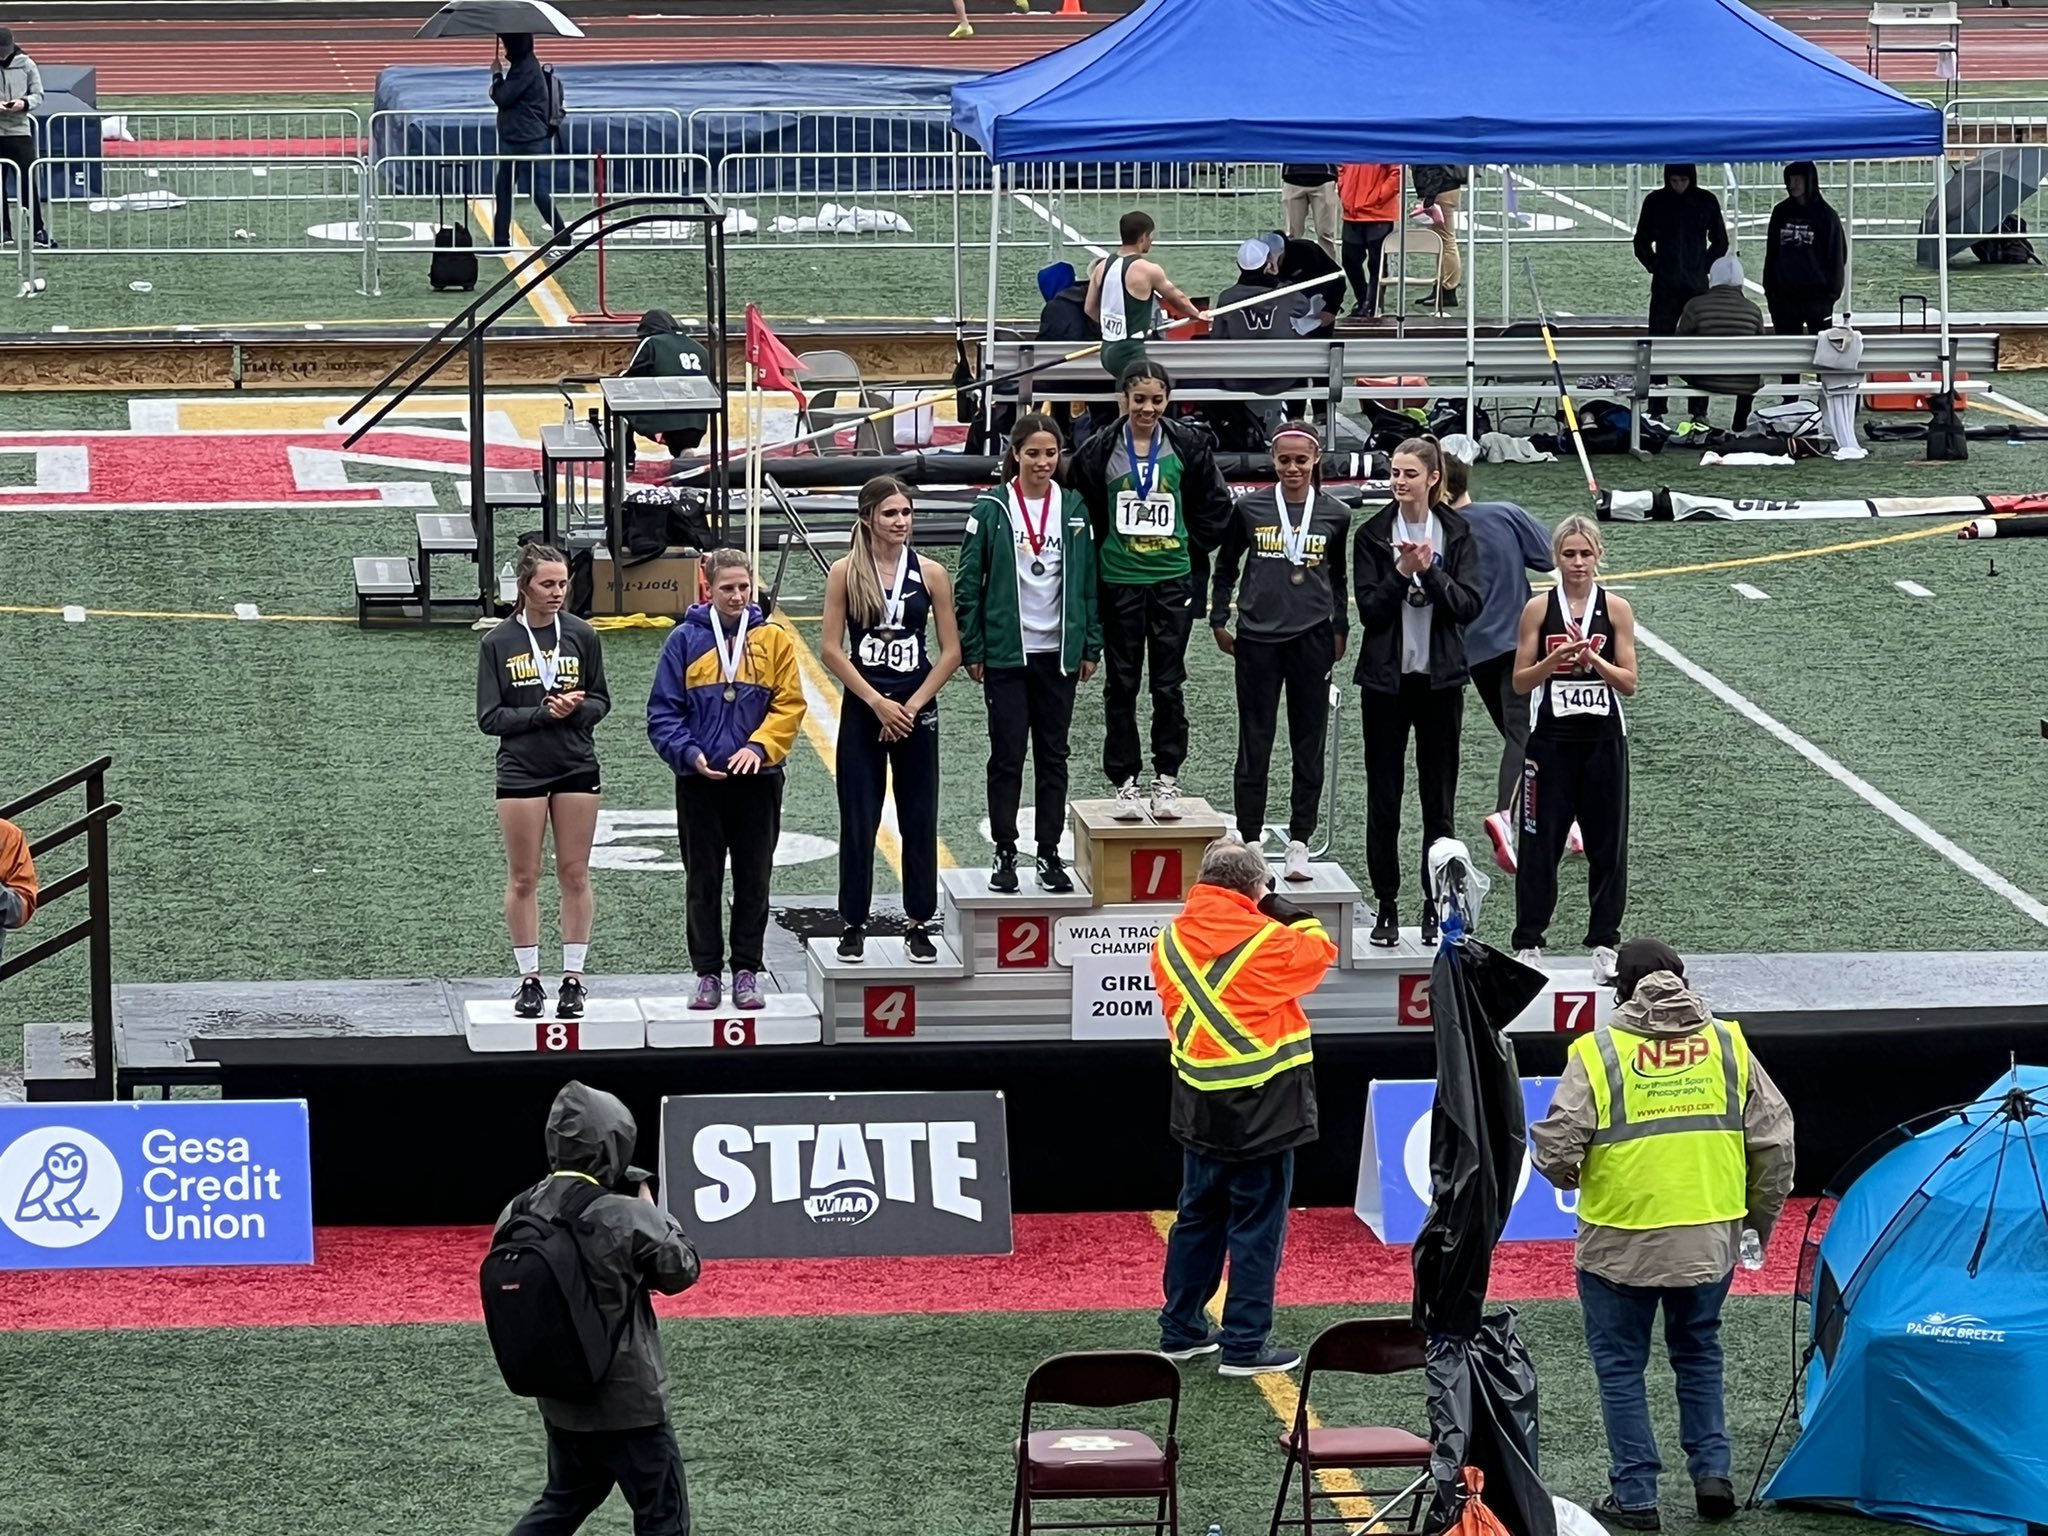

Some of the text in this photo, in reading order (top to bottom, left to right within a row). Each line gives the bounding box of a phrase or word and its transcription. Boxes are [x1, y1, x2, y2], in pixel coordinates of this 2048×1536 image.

[1122, 501, 1169, 527] 1740
[1253, 532, 1327, 553] TUMTER
[606, 579, 679, 592] Sport-Tk
[867, 642, 914, 668] 1491
[505, 656, 580, 681] TUMTER
[1559, 688, 1608, 709] 1404
[1146, 855, 1166, 894] 1
[1005, 921, 1041, 962] 2
[1069, 926, 1161, 939] WIAA TRAC
[872, 991, 906, 1030] 4
[1092, 1000, 1153, 1016] 200M
[1407, 980, 1432, 1019] 5
[1562, 995, 1588, 1029] 7
[545, 1023, 568, 1051] 8
[723, 1020, 746, 1046] 6
[1637, 1037, 1710, 1071] NSP
[1634, 1078, 1683, 1091] Northwest
[1646, 1085, 1706, 1099] Photography
[142, 1128, 250, 1165] Gesa
[143, 1164, 282, 1203] Credit
[692, 1121, 983, 1224] STATE
[816, 1196, 869, 1213] WIAA
[145, 1204, 266, 1241] Union
[1906, 1322, 1957, 1338] PACIFIC
